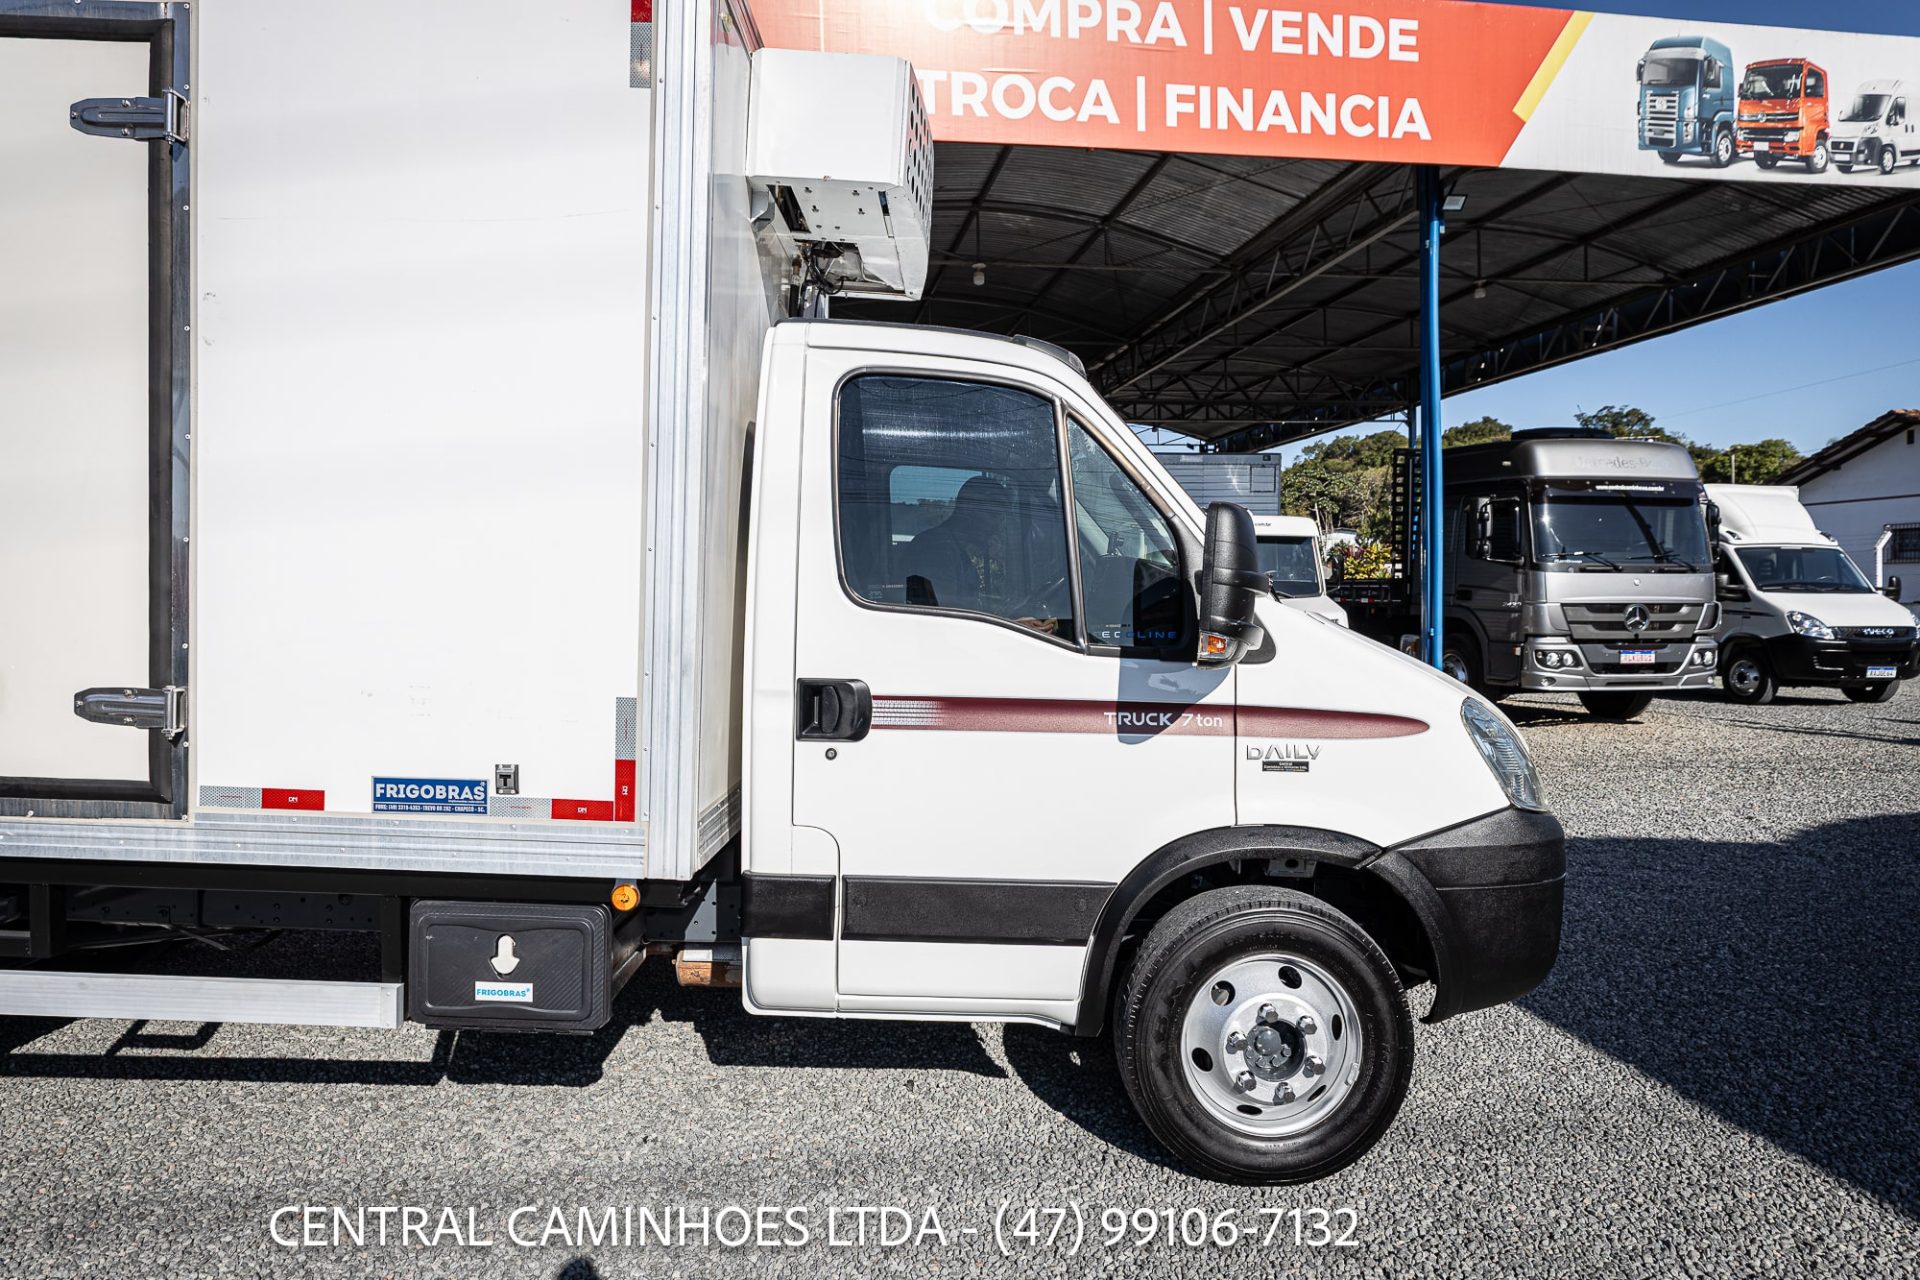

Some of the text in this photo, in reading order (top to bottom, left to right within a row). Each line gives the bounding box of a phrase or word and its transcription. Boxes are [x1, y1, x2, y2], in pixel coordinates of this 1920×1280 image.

[923, 0, 1188, 47] COMPRA
[1228, 6, 1419, 62] VENDE
[914, 68, 1121, 124] TROCA
[1165, 83, 1432, 141] FINANCIA
[1862, 627, 1895, 636] IVECO
[1103, 711, 1224, 728] TRUCK 7 ton
[1246, 743, 1321, 760] DAILY
[375, 783, 485, 801] FRIGOBRAS
[477, 988, 526, 997] FRIGOBRAS
